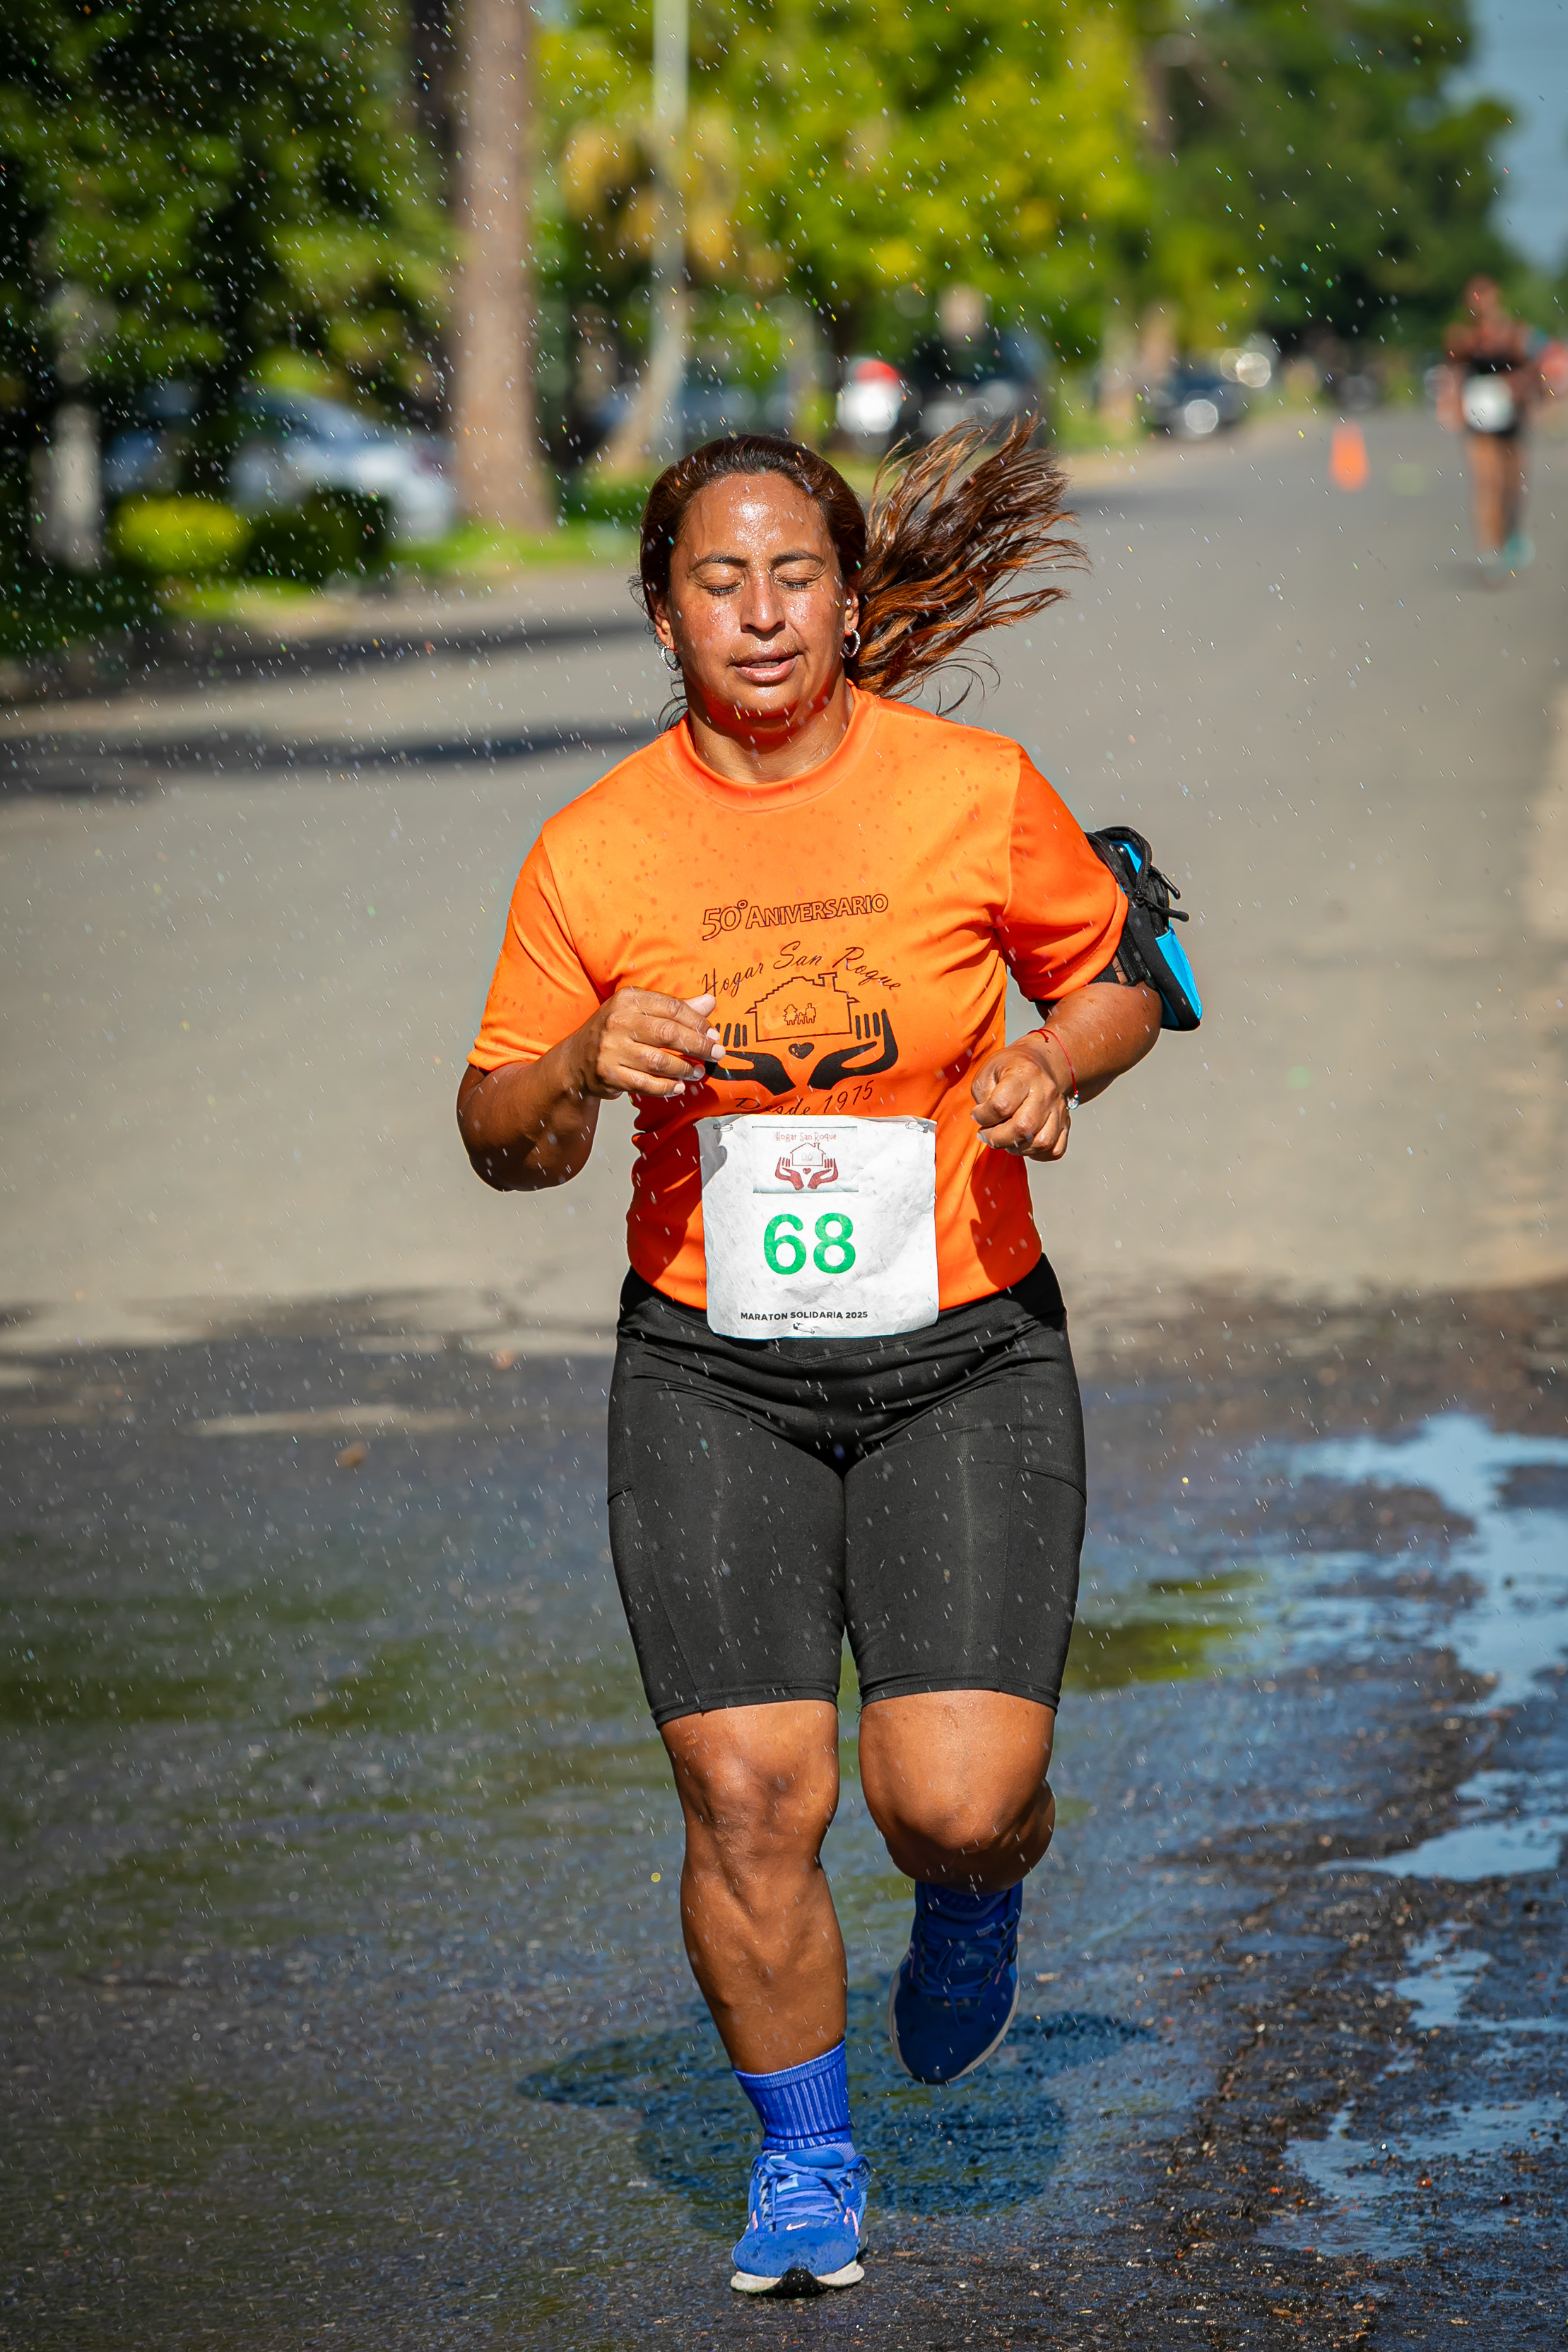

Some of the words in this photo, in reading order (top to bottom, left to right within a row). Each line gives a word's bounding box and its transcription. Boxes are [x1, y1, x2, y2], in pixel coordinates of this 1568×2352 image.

[701, 962, 764, 998] Hogar
[773, 941, 824, 970] San
[733, 1097, 810, 1115] Desde
[823, 1079, 875, 1114] 1975
[776, 1131, 797, 1142] Hogar
[799, 1132, 813, 1142] San
[814, 1131, 837, 1142] Roque
[763, 1213, 856, 1275] 68
[741, 1312, 788, 1321] MARATON
[790, 1311, 844, 1319] SOLIDARIA
[845, 1311, 868, 1319] 2025
